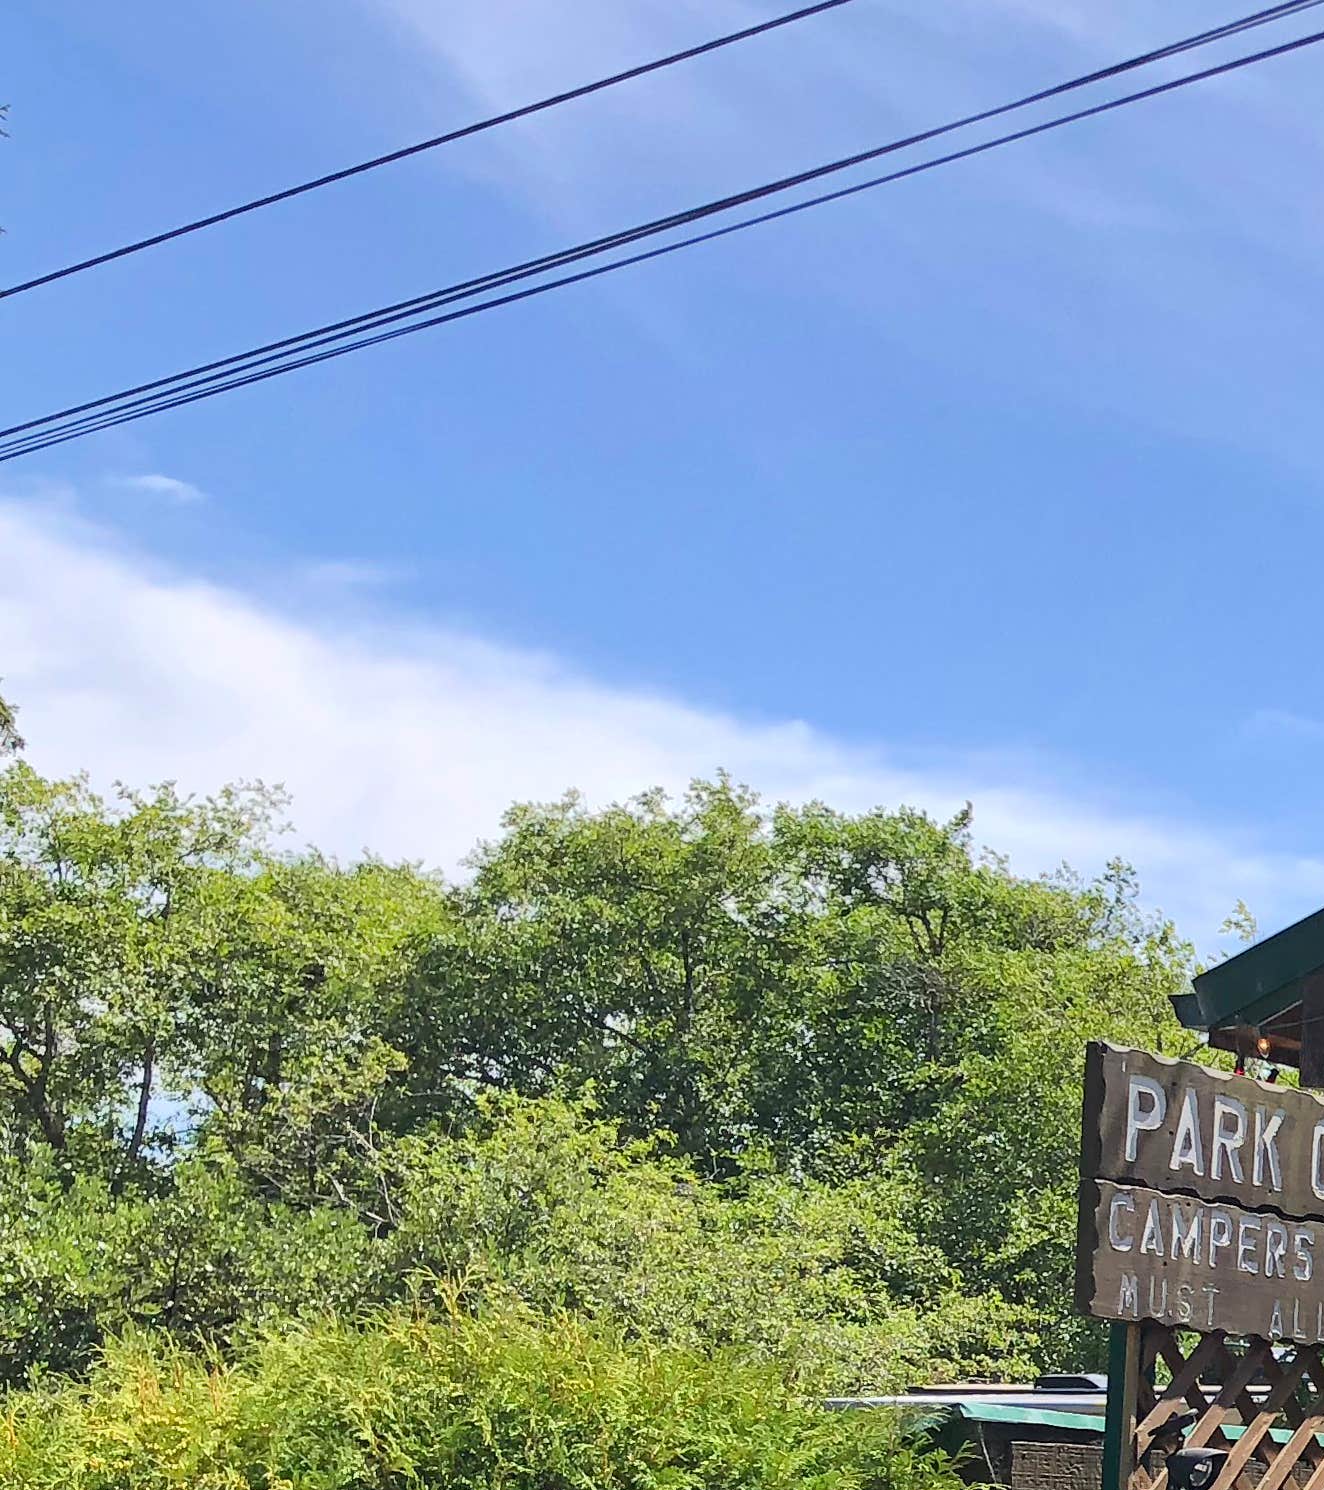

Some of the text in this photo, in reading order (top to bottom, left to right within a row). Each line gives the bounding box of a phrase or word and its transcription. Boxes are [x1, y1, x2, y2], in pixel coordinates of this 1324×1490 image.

[1125, 1074, 1286, 1192] PARK
[1108, 1193, 1315, 1281] CAMPERS
[1117, 1273, 1221, 1327] MUST
